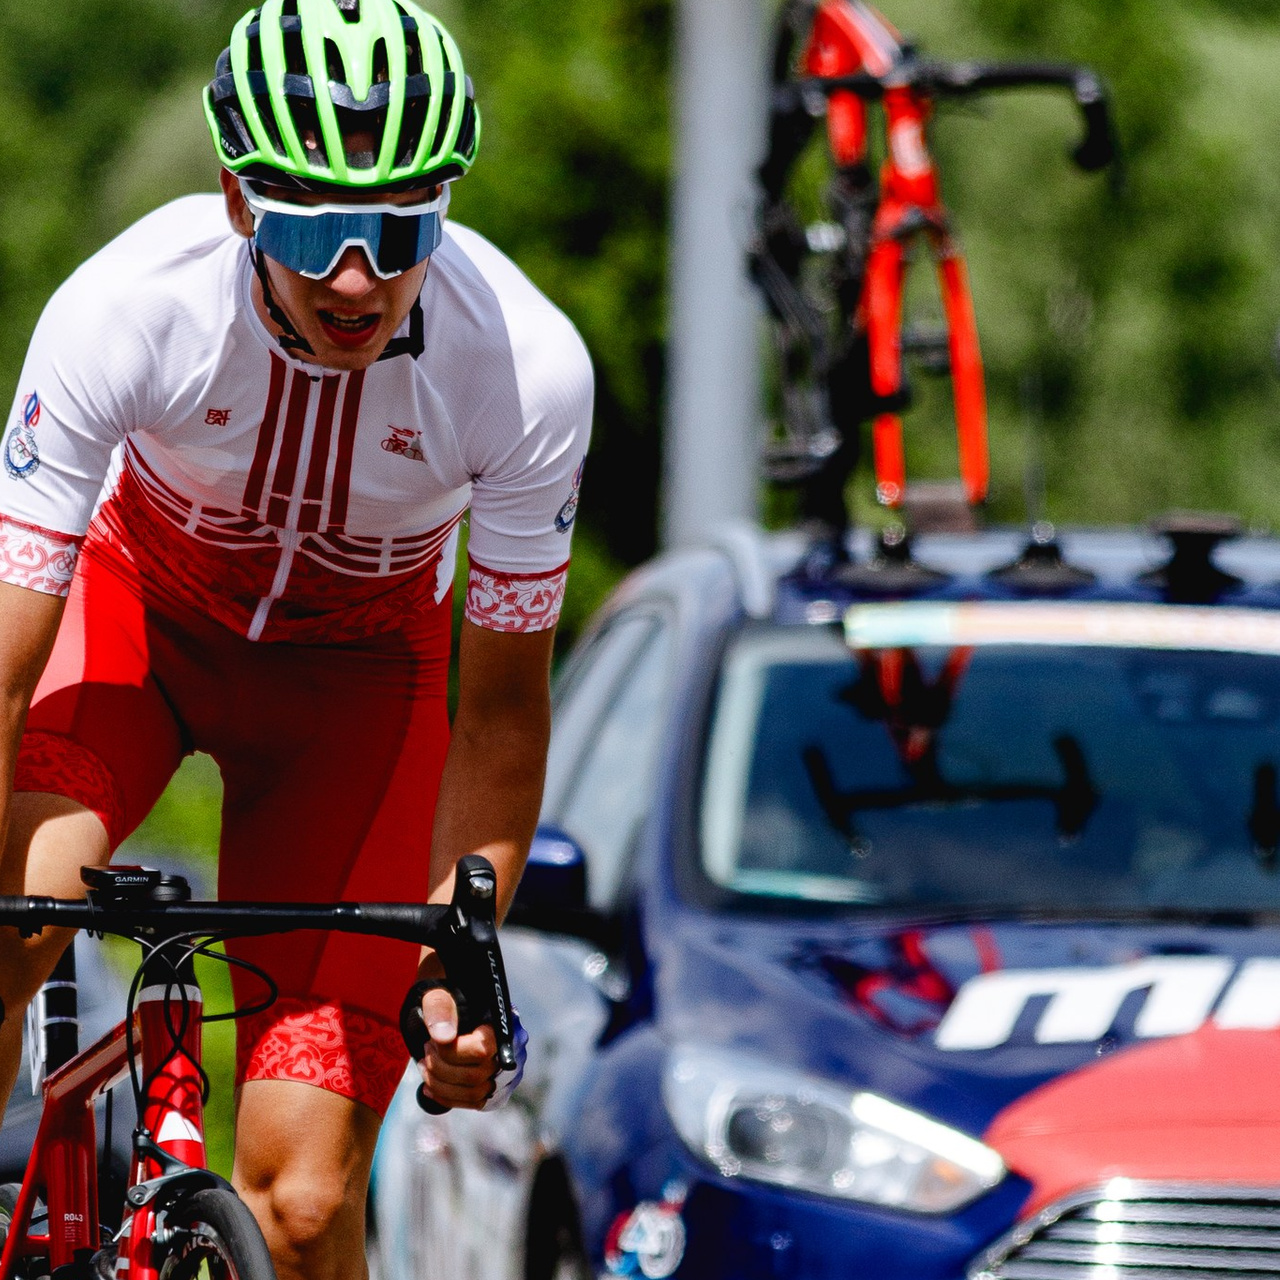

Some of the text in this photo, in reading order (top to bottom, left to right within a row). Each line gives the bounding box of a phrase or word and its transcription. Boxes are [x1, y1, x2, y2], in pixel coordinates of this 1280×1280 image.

[207, 408, 232, 419] FAT
[204, 417, 231, 426] CAT
[487, 950, 509, 1036] ULTEGRA
